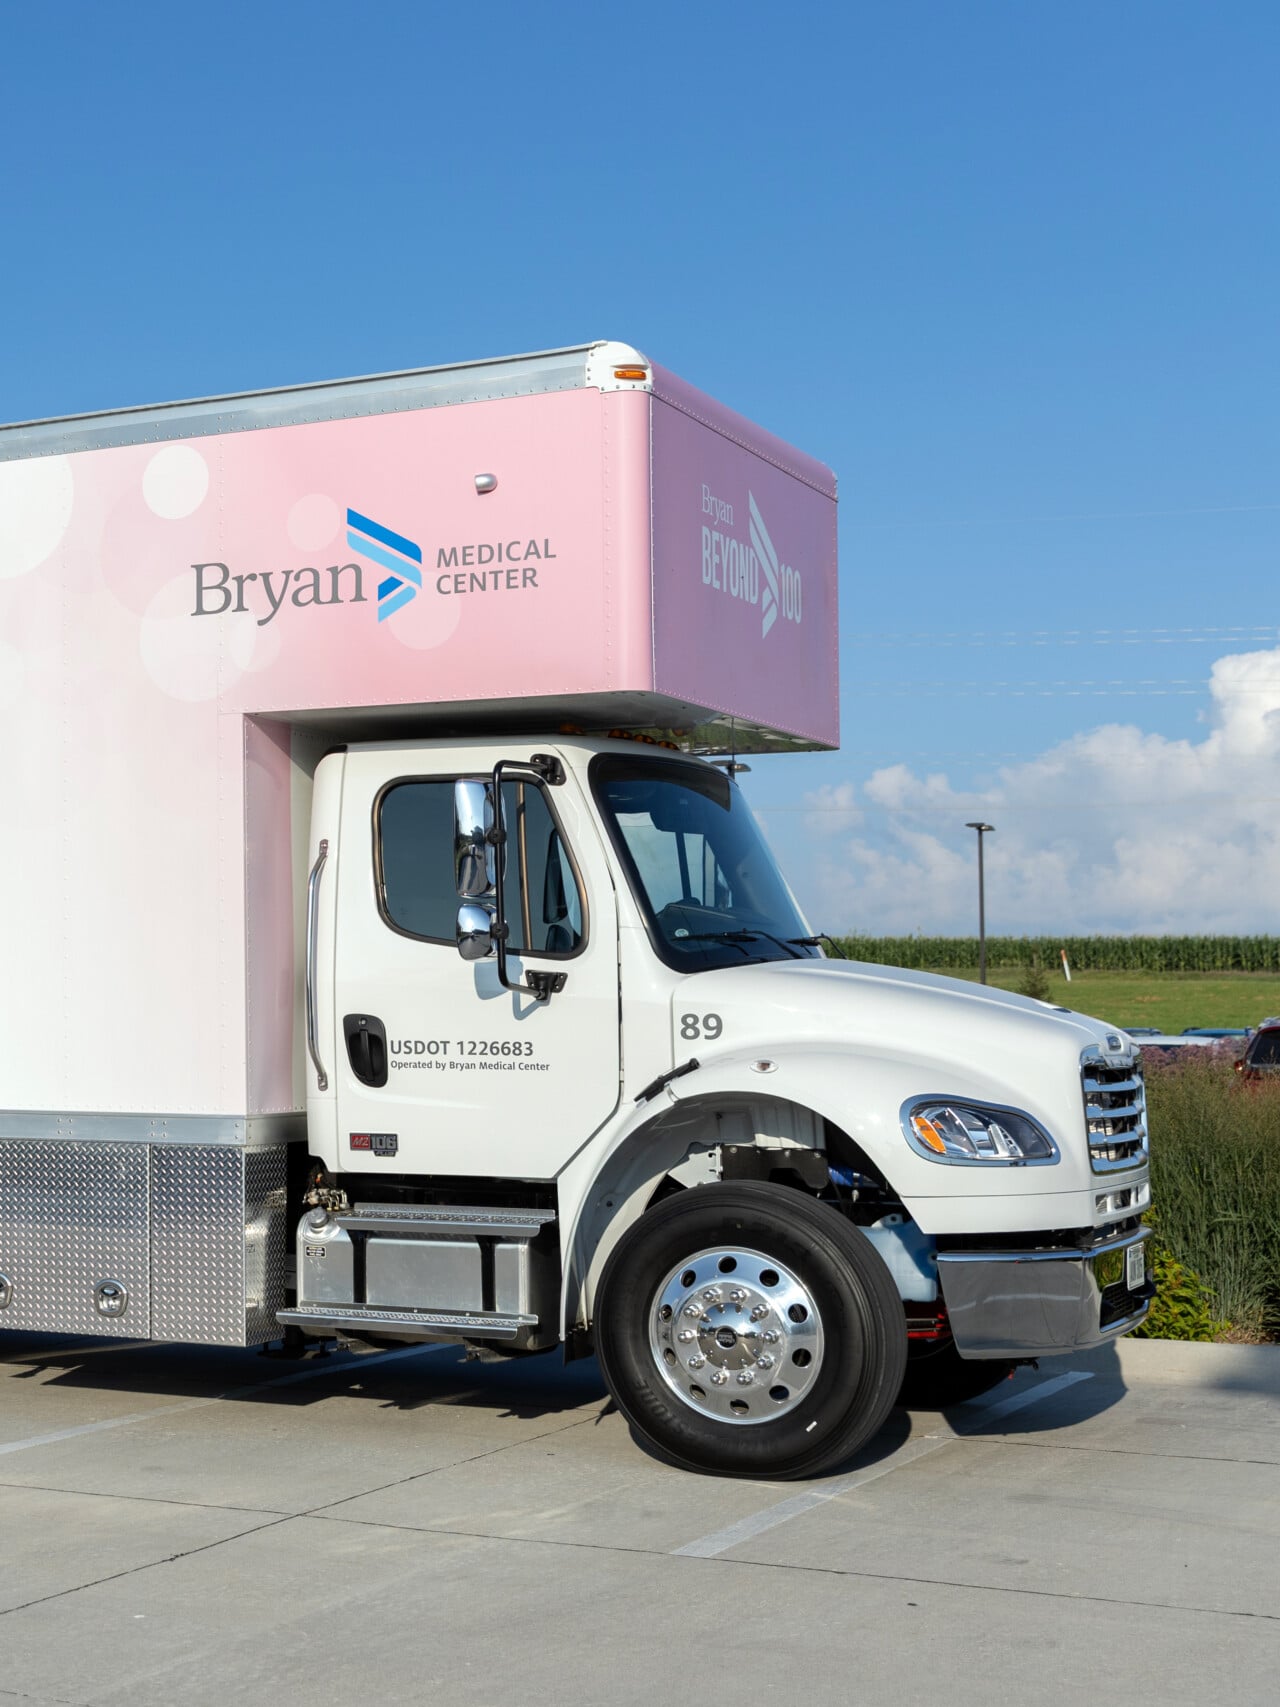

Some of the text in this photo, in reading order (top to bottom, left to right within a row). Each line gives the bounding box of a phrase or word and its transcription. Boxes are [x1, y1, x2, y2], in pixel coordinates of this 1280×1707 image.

[701, 483, 734, 526] Bryan
[436, 539, 558, 569] MEDICAL
[436, 567, 539, 595] CENTER
[701, 525, 803, 625] BEYOND 100
[190, 562, 368, 627] Bryan
[679, 1013, 724, 1041] 89
[390, 1039, 534, 1057] USDOT 1226683
[390, 1060, 551, 1072] Operated by Bryan Medical Center
[371, 1135, 398, 1150] 106
